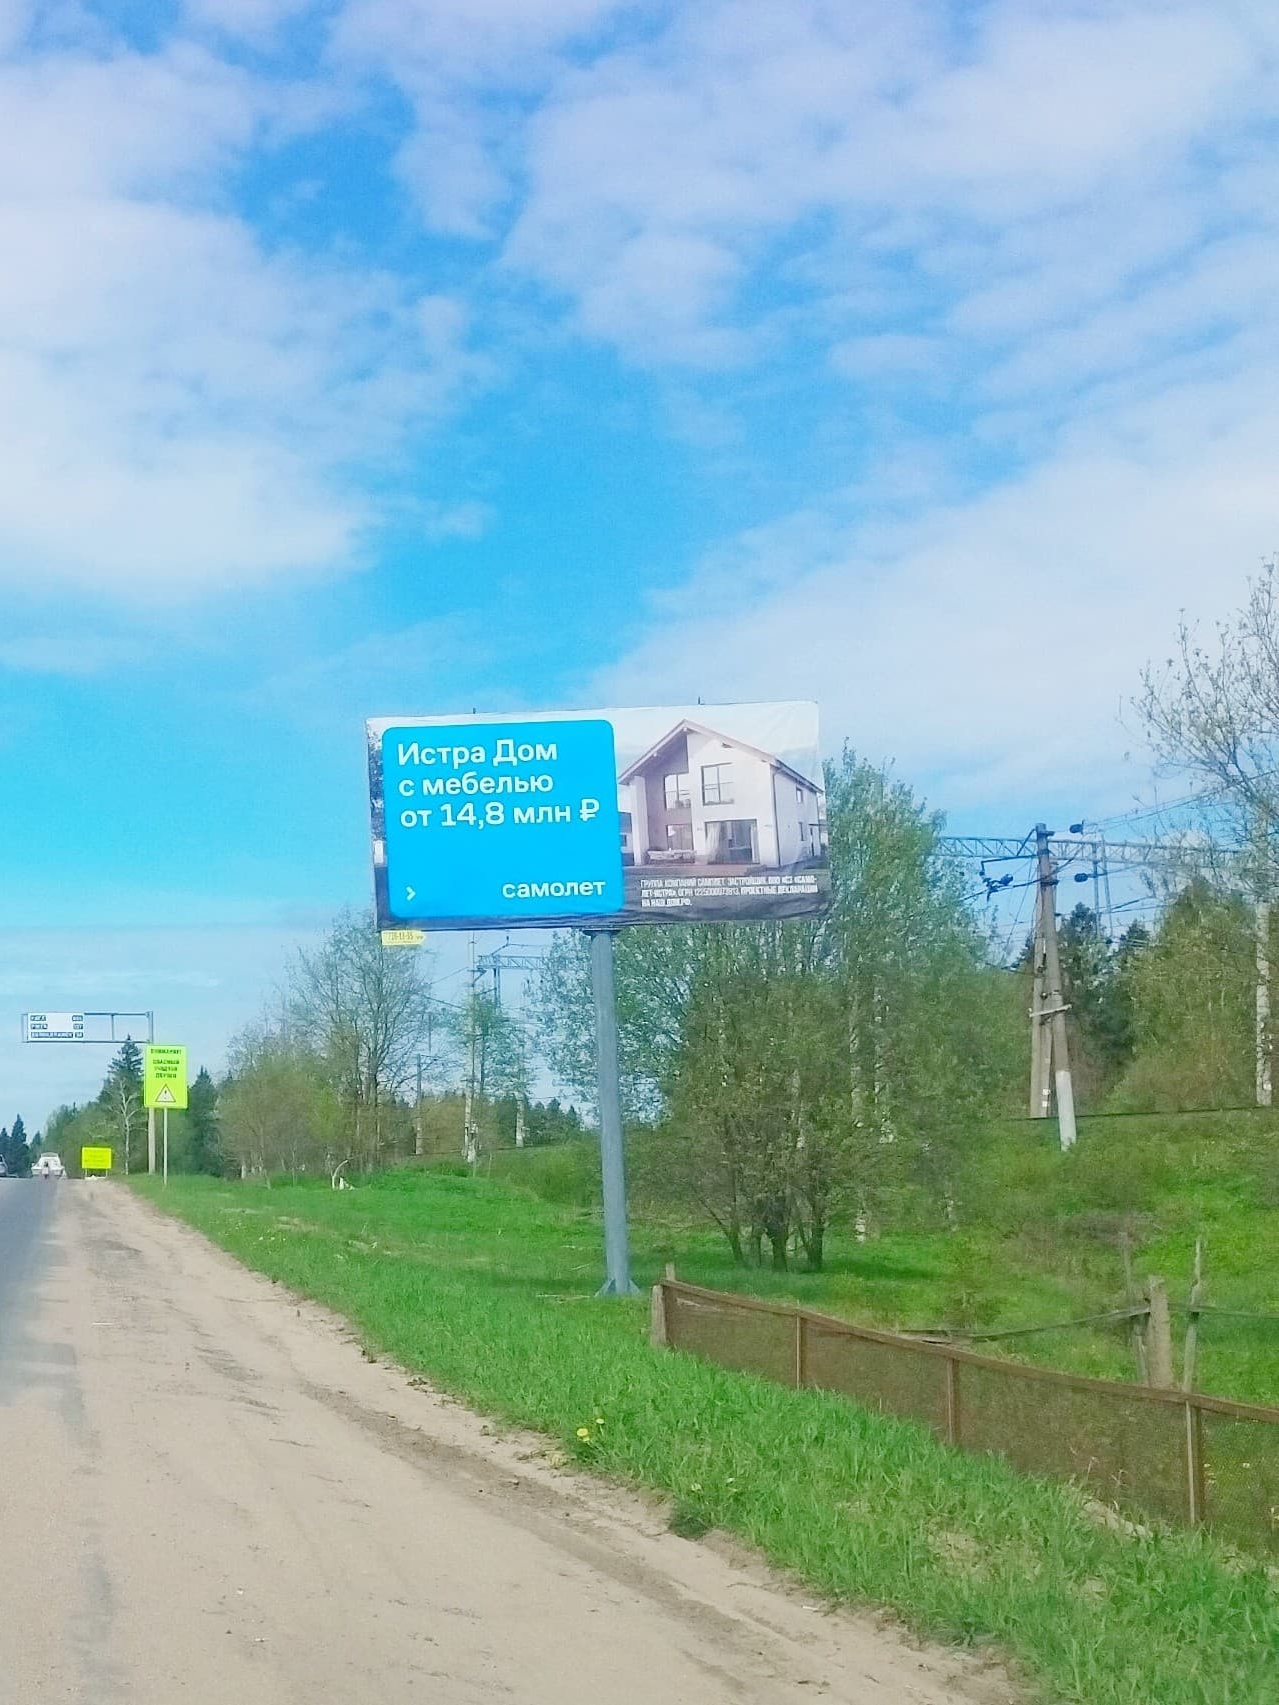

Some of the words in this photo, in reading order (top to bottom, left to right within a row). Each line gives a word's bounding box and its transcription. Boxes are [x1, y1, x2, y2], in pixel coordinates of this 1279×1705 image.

[397, 743, 486, 769] Истра
[492, 739, 557, 766] Дом
[398, 779, 415, 797] с
[422, 771, 554, 796] мебелью
[400, 809, 432, 827] от
[440, 801, 505, 829] 14,8
[513, 805, 571, 824] млн
[502, 881, 606, 899] самолет
